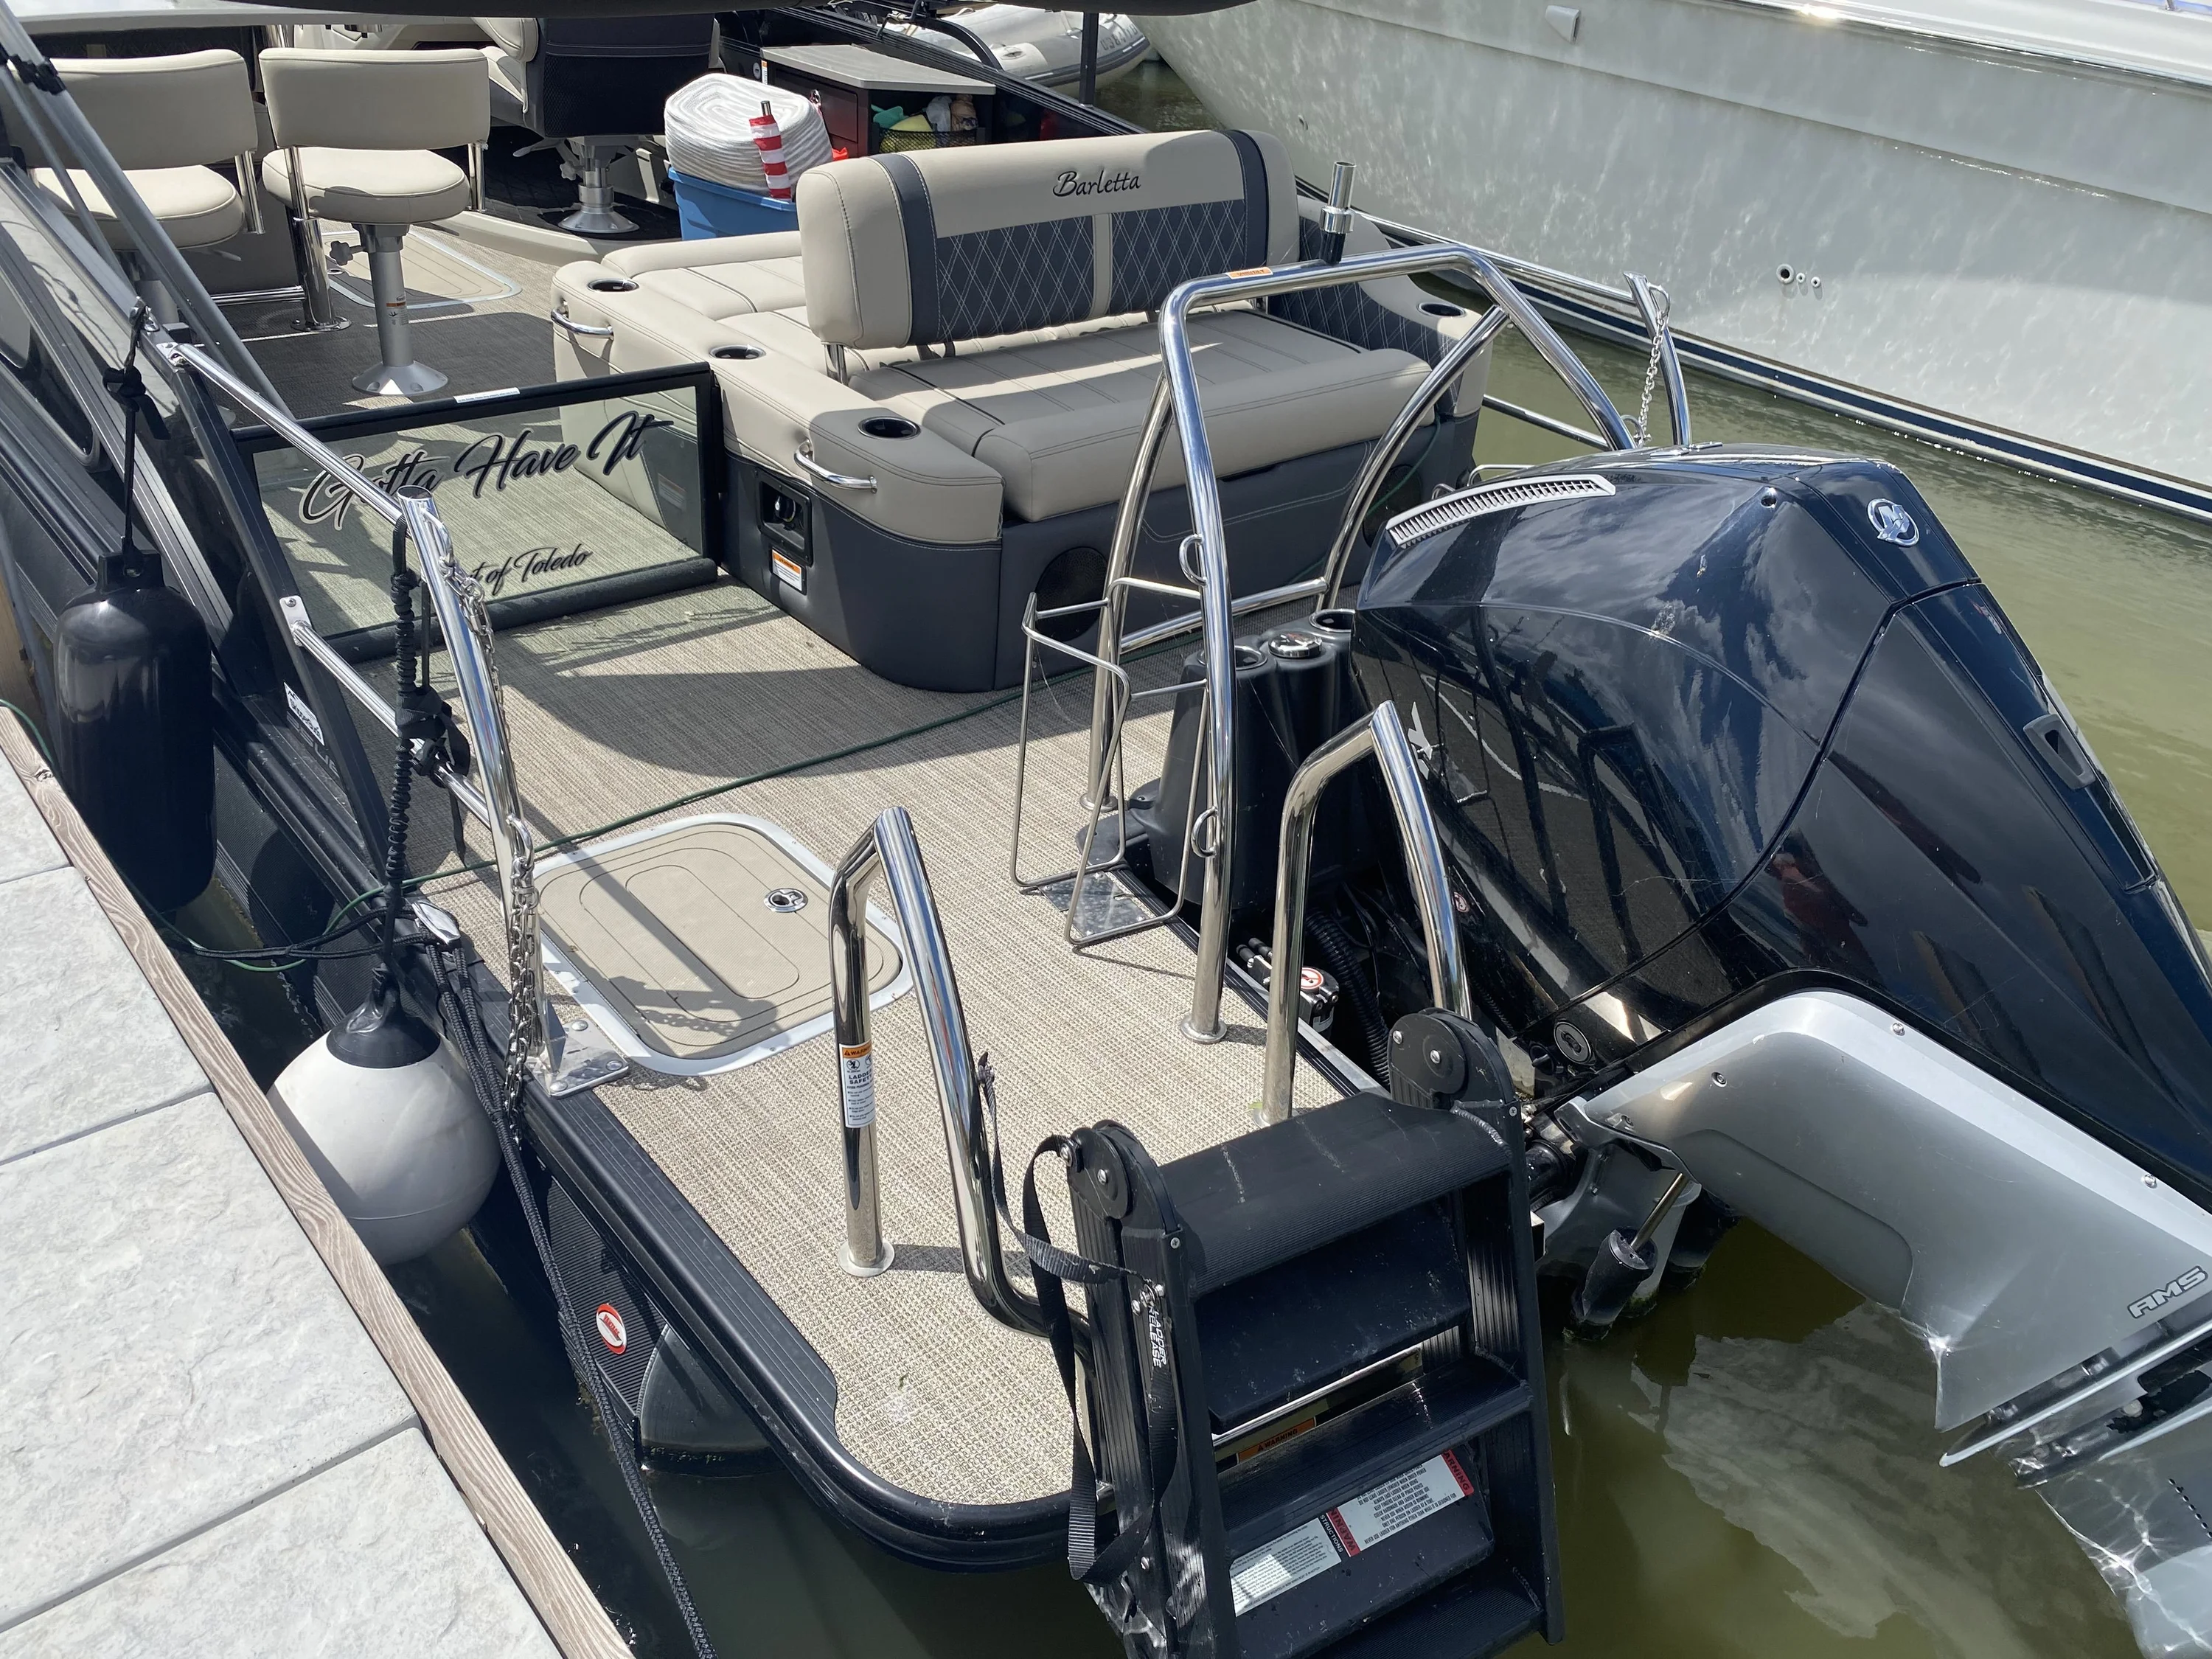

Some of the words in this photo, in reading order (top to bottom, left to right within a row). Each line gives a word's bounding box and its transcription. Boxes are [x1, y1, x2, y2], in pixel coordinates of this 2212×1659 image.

[1052, 167, 1141, 198] Barletta
[454, 428, 580, 498] Have
[588, 410, 673, 476] It
[485, 556, 513, 596] of
[513, 543, 594, 583] Toledo
[851, 1046, 870, 1056] WARN
[2127, 1265, 2208, 1318] AMS
[1148, 1306, 1161, 1368] RELEASE
[1153, 1310, 1166, 1366] LADDER
[1263, 1427, 1298, 1449] WARNING
[1444, 1451, 1470, 1490] ARNING
[1320, 1514, 1343, 1552] STRUCTIONS
[1330, 1510, 1356, 1551] WARNIN
